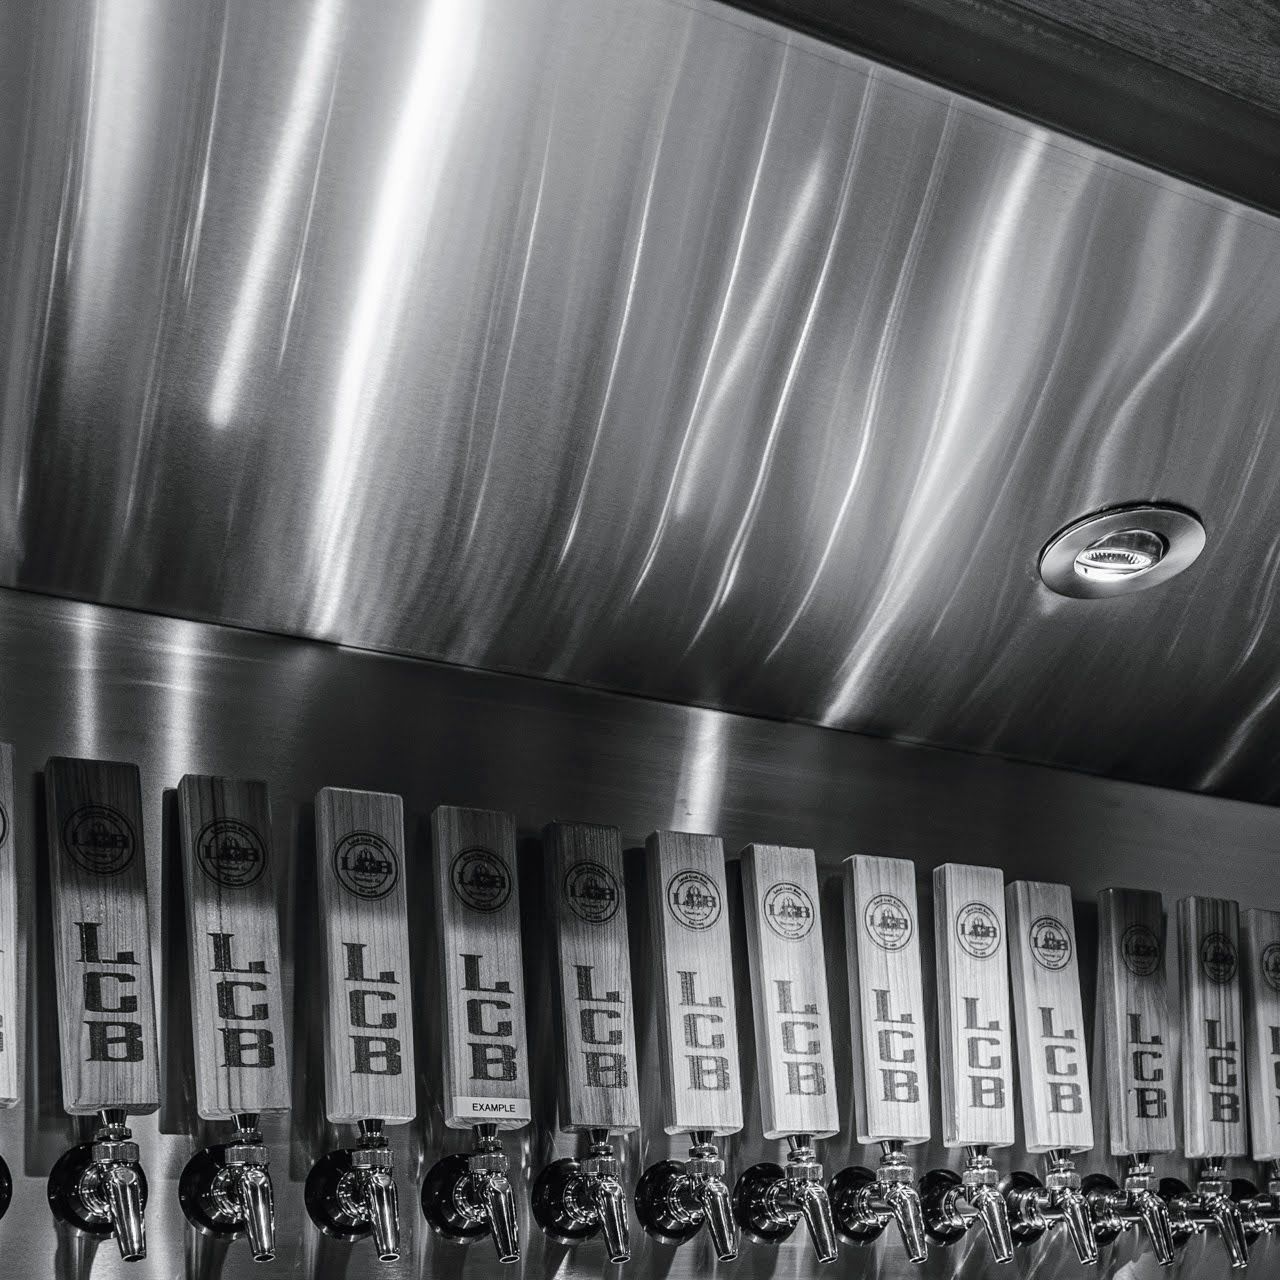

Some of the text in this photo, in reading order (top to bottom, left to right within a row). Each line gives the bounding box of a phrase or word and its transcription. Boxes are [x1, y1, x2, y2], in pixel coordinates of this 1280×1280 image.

[73, 921, 145, 1063] LCB
[207, 932, 275, 1069] LCB
[341, 942, 402, 1076] LCB
[459, 953, 518, 1082] LCB
[572, 965, 629, 1088] LCB
[676, 971, 731, 1091] LCB
[773, 980, 827, 1096] LCB
[871, 989, 920, 1103] LCB
[472, 1102, 516, 1112] EXAMPLE
[962, 997, 1006, 1109] LCB
[1038, 1007, 1083, 1114] LCB
[1126, 1013, 1168, 1120] LCB
[1204, 1019, 1241, 1123] LCB
